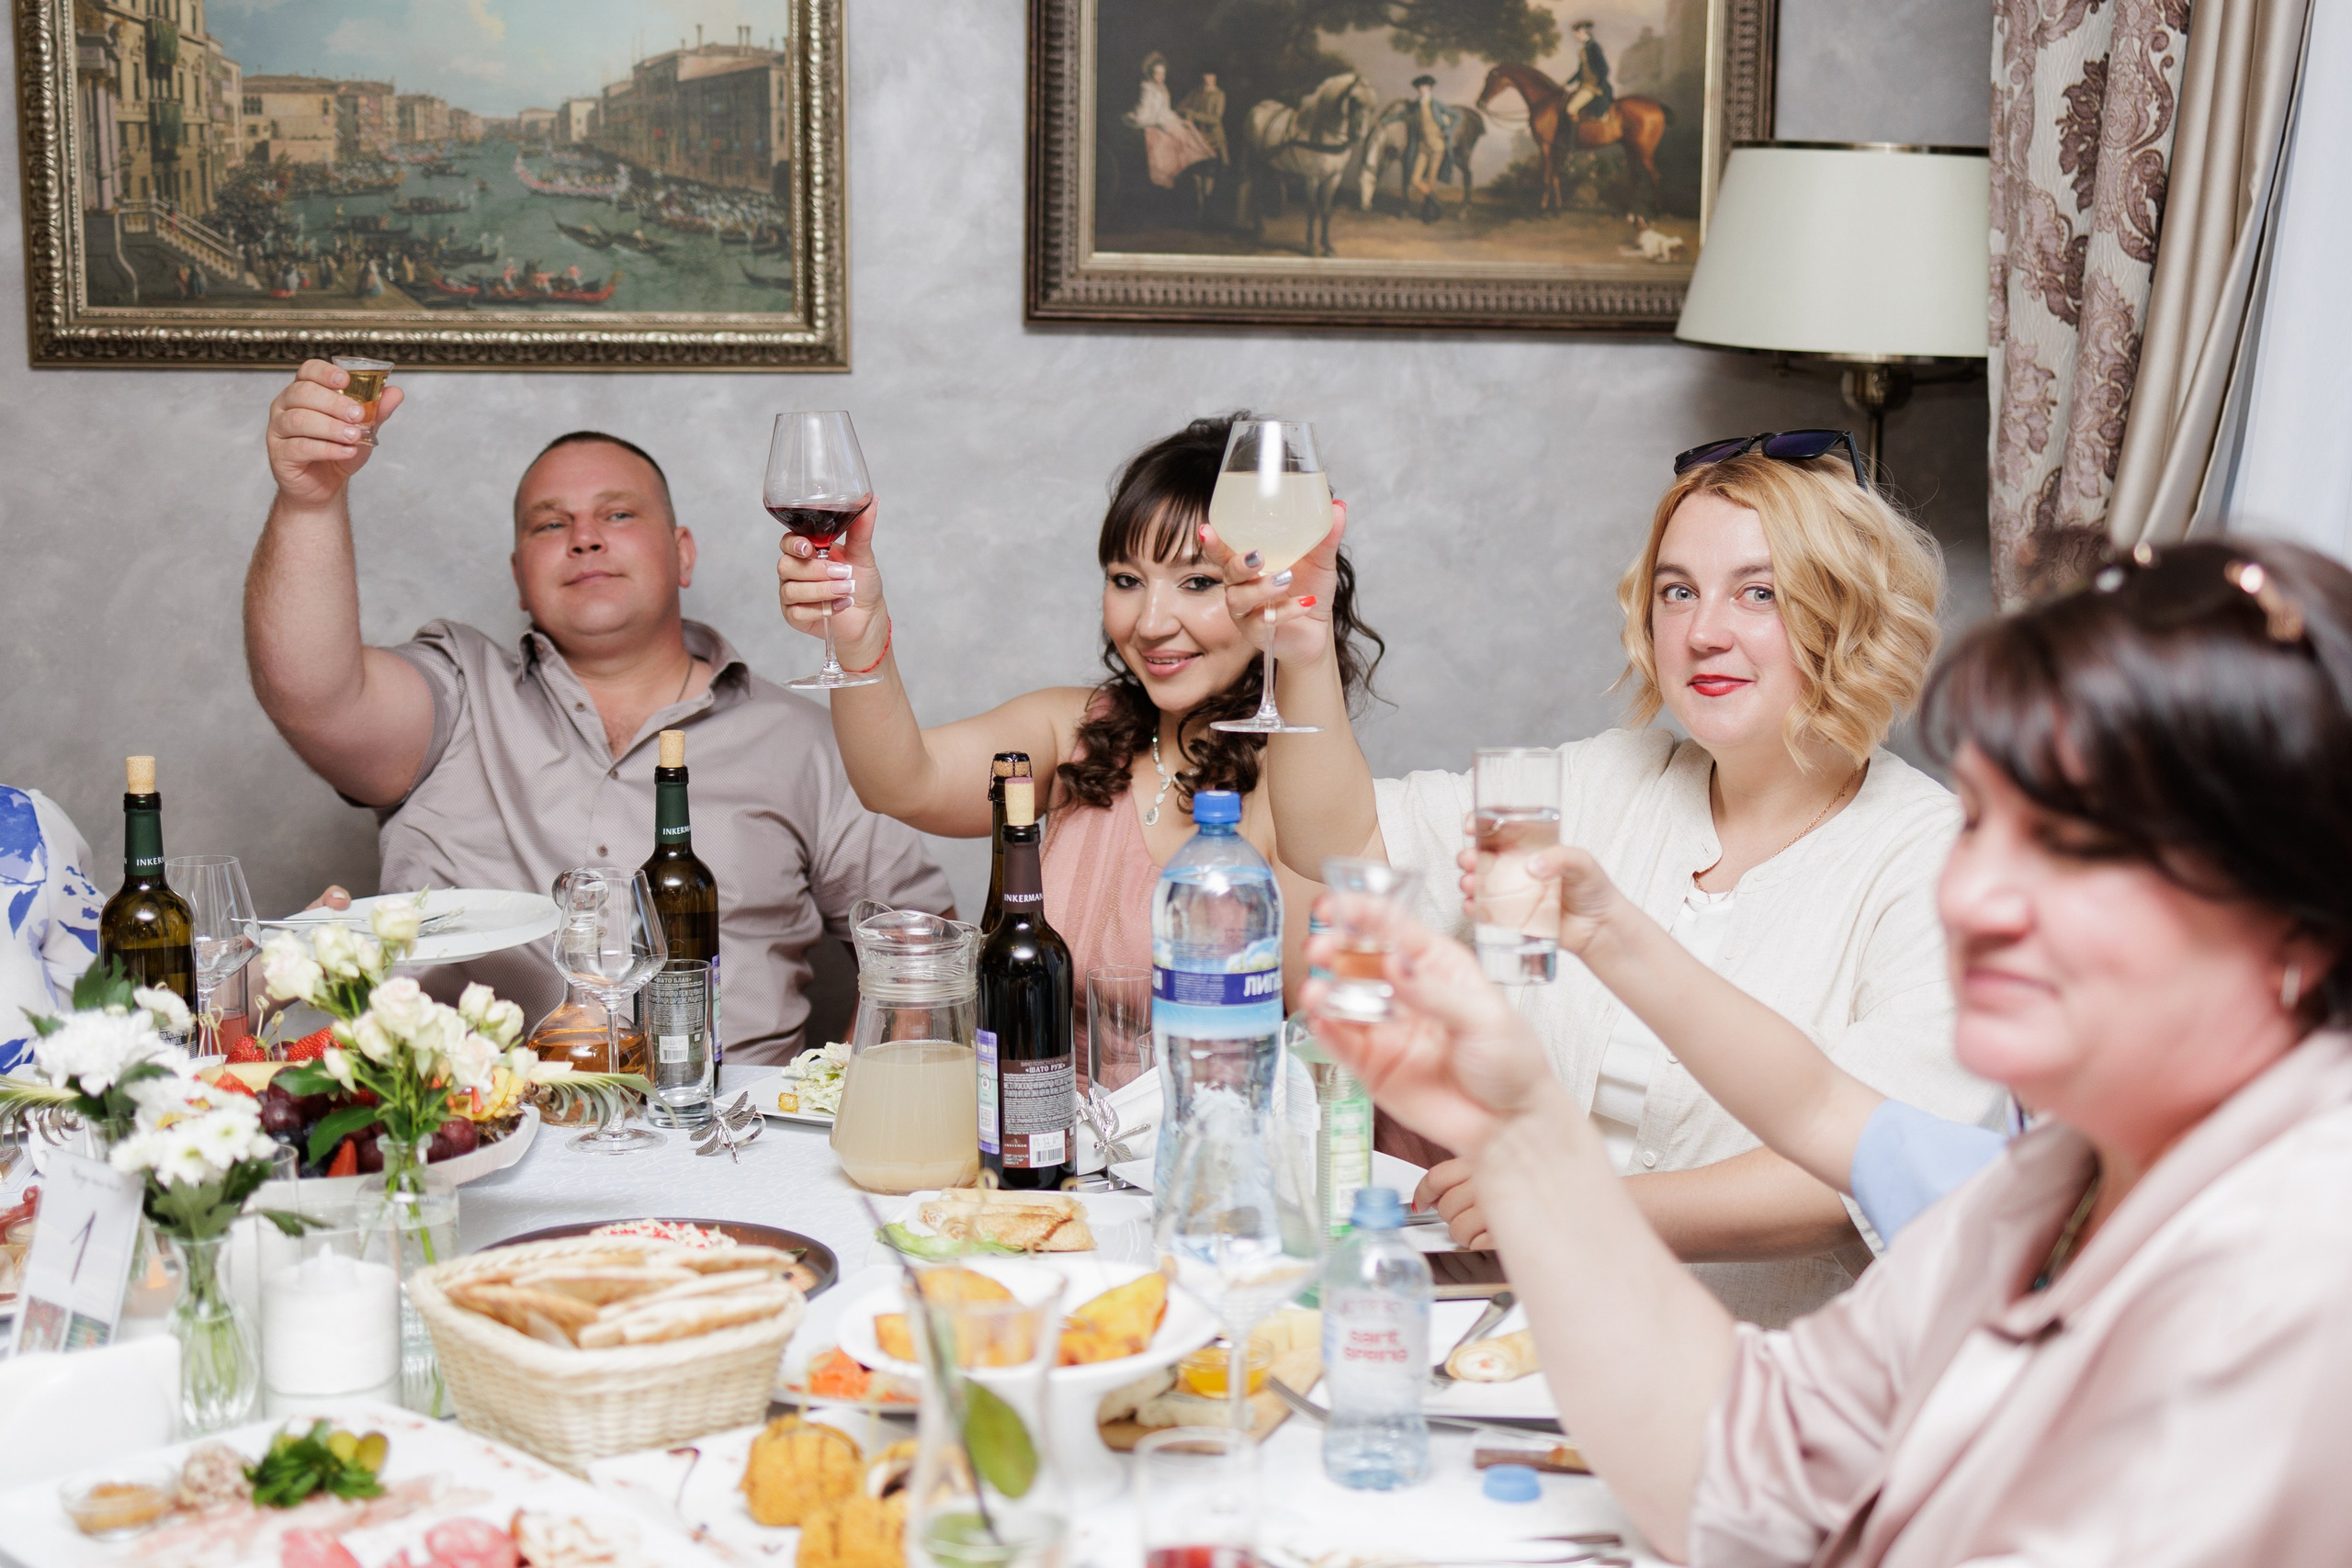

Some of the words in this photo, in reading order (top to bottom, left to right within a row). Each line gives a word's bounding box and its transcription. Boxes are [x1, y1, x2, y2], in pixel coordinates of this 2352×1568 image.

[663, 826, 691, 835] INKERM
[1004, 893, 1043, 902] INKERMAN
[70, 1210, 97, 1285] 1
